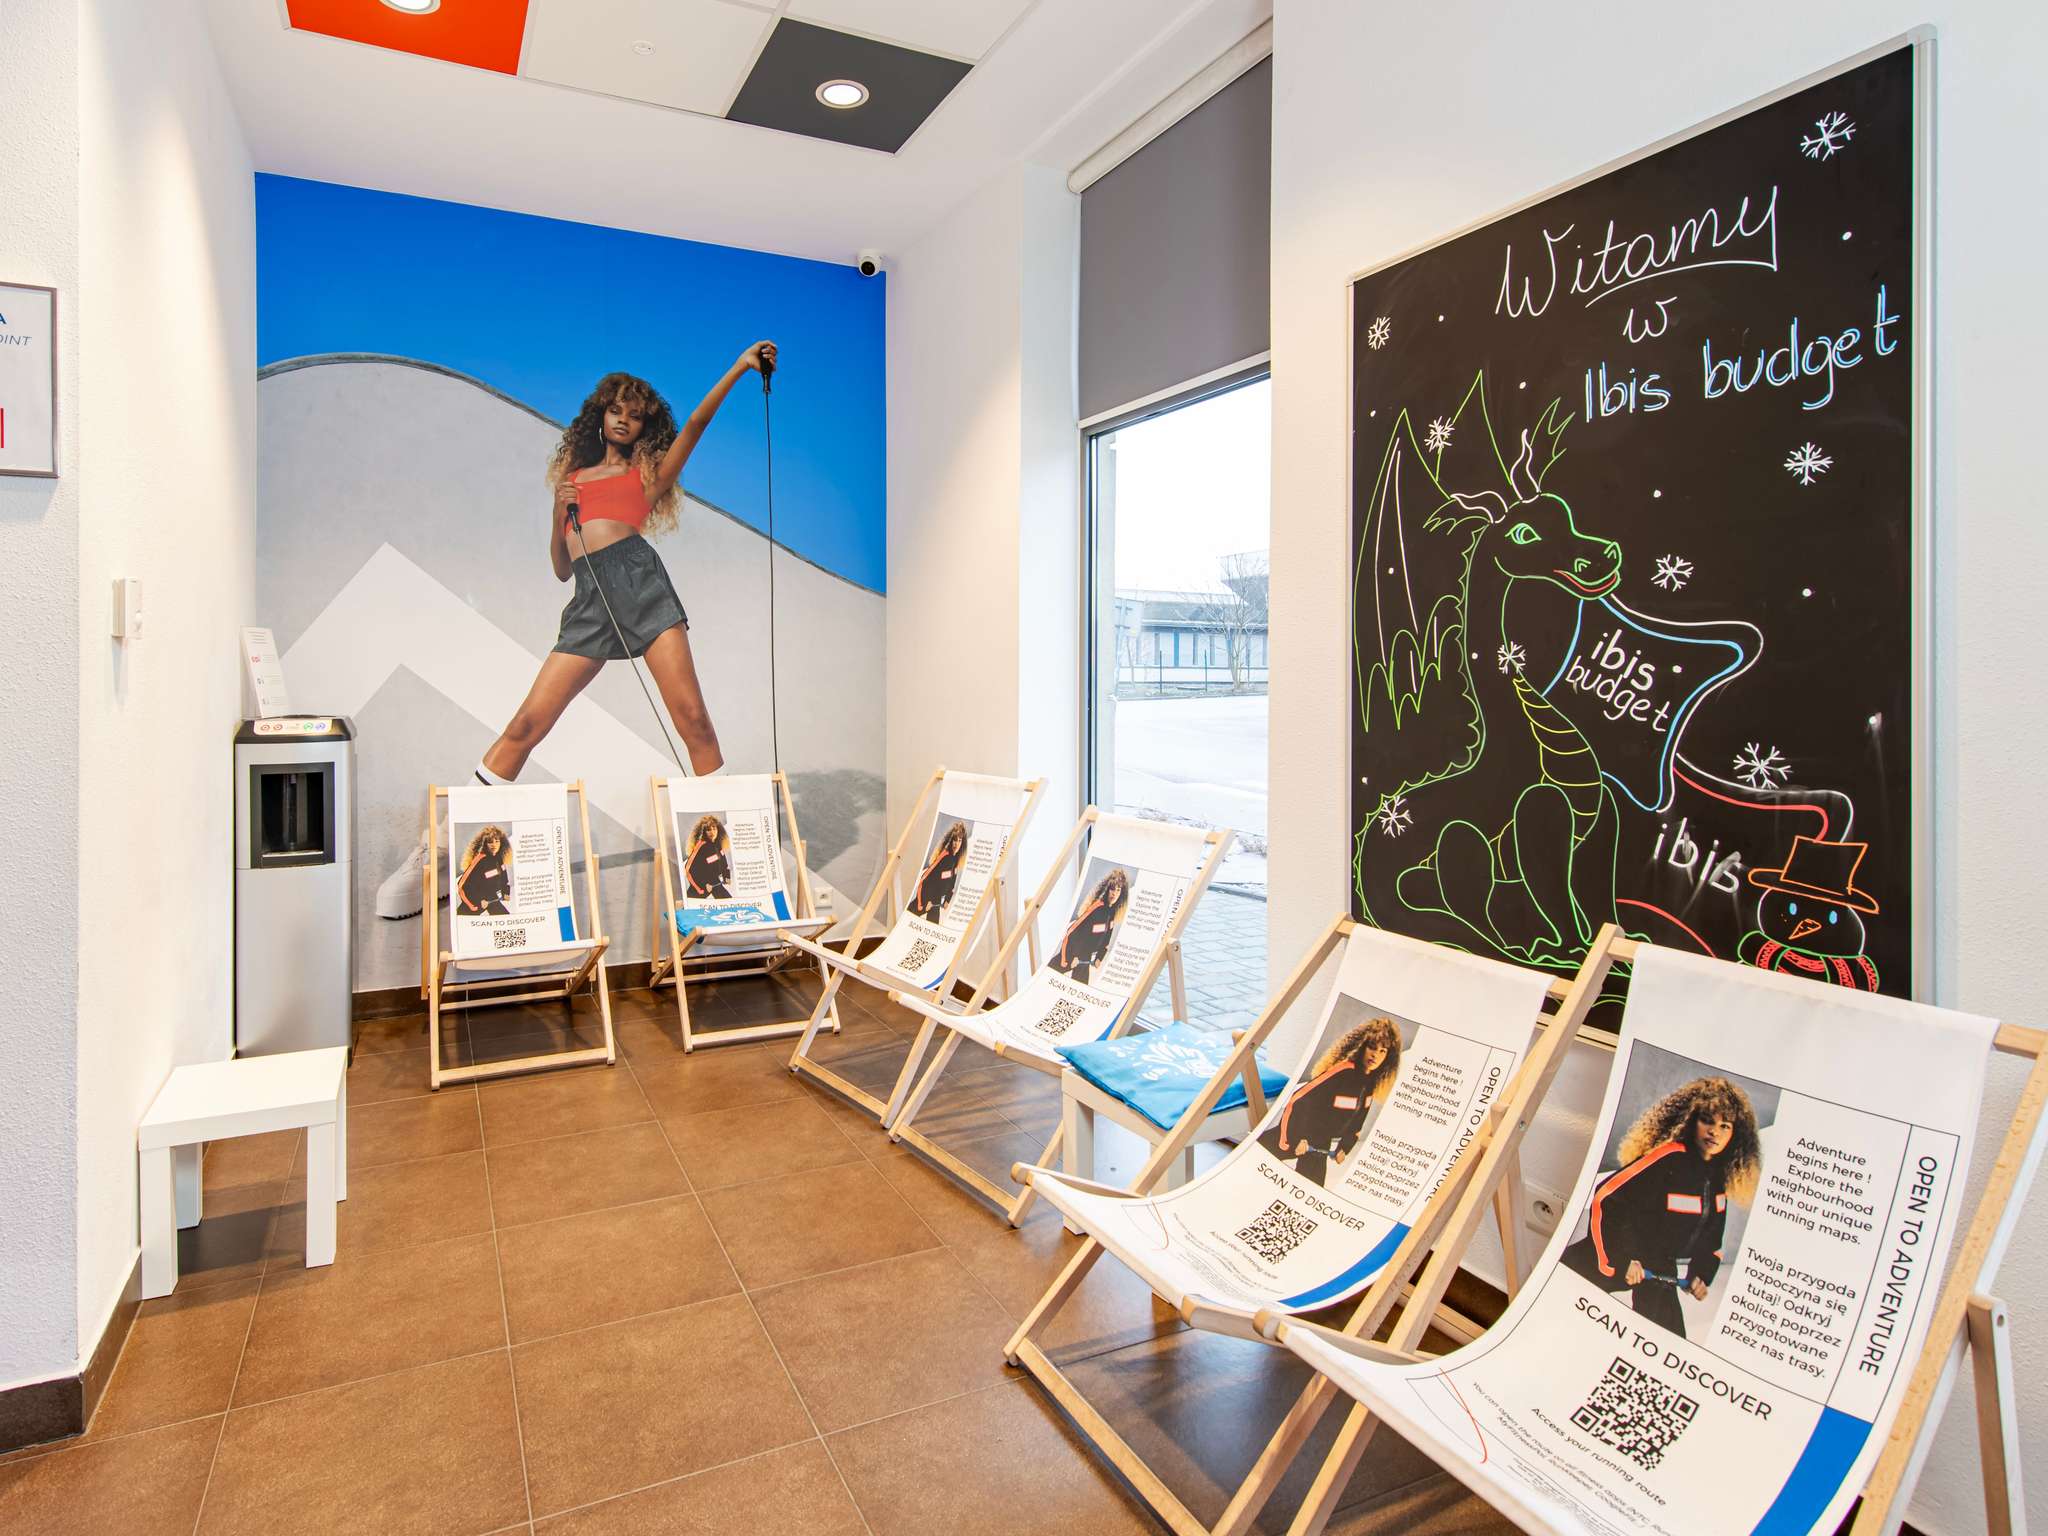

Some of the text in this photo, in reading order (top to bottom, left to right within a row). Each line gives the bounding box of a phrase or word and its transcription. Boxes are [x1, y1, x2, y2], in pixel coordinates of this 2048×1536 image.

[1495, 186, 1777, 318] Witamy
[1704, 284, 1899, 411] budget
[1591, 629, 1655, 690] ibis
[1566, 656, 1670, 731] budget
[1654, 817, 1742, 893] ibis
[507, 916, 546, 926] DISCOVER
[1048, 978, 1111, 1008] SCAN TO DISCOVER
[1412, 1074, 1456, 1095] Explore the
[1414, 1064, 1438, 1079] begins
[1440, 1073, 1458, 1085] here
[1422, 1057, 1462, 1074] Adventure
[1479, 1067, 1500, 1104] OPEN
[1393, 1101, 1424, 1118] running
[1396, 1090, 1457, 1118] with our unique
[1401, 1082, 1460, 1108] neighbourhood
[1470, 1108, 1485, 1126] TO
[1375, 1130, 1437, 1160] Twoja przygoda
[1787, 1148, 1828, 1171] begins
[1832, 1162, 1864, 1181] here
[1797, 1137, 1866, 1166] Adventure
[1258, 1162, 1364, 1231] SCAN TO DISCOVER
[1771, 1174, 1874, 1216] neighbourhood
[1788, 1164, 1864, 1196] Explore the
[1766, 1187, 1873, 1232] with our unique
[1766, 1204, 1862, 1245] running maps.
[1748, 1248, 1856, 1299] Twoja przygoda
[1858, 1156, 1938, 1376] OPEN TO ADVENTURE
[1745, 1266, 1848, 1316] rozpoczyna się
[1747, 1283, 1832, 1328] tutaj! Odkryj
[1729, 1310, 1828, 1360] przygotowane
[1732, 1294, 1842, 1348] okolicę poprzez
[1575, 1297, 1772, 1420] SCAN TO DISCOVER
[1721, 1324, 1826, 1378] przez nas trasy.
[1531, 1408, 1666, 1506] Access your running route
